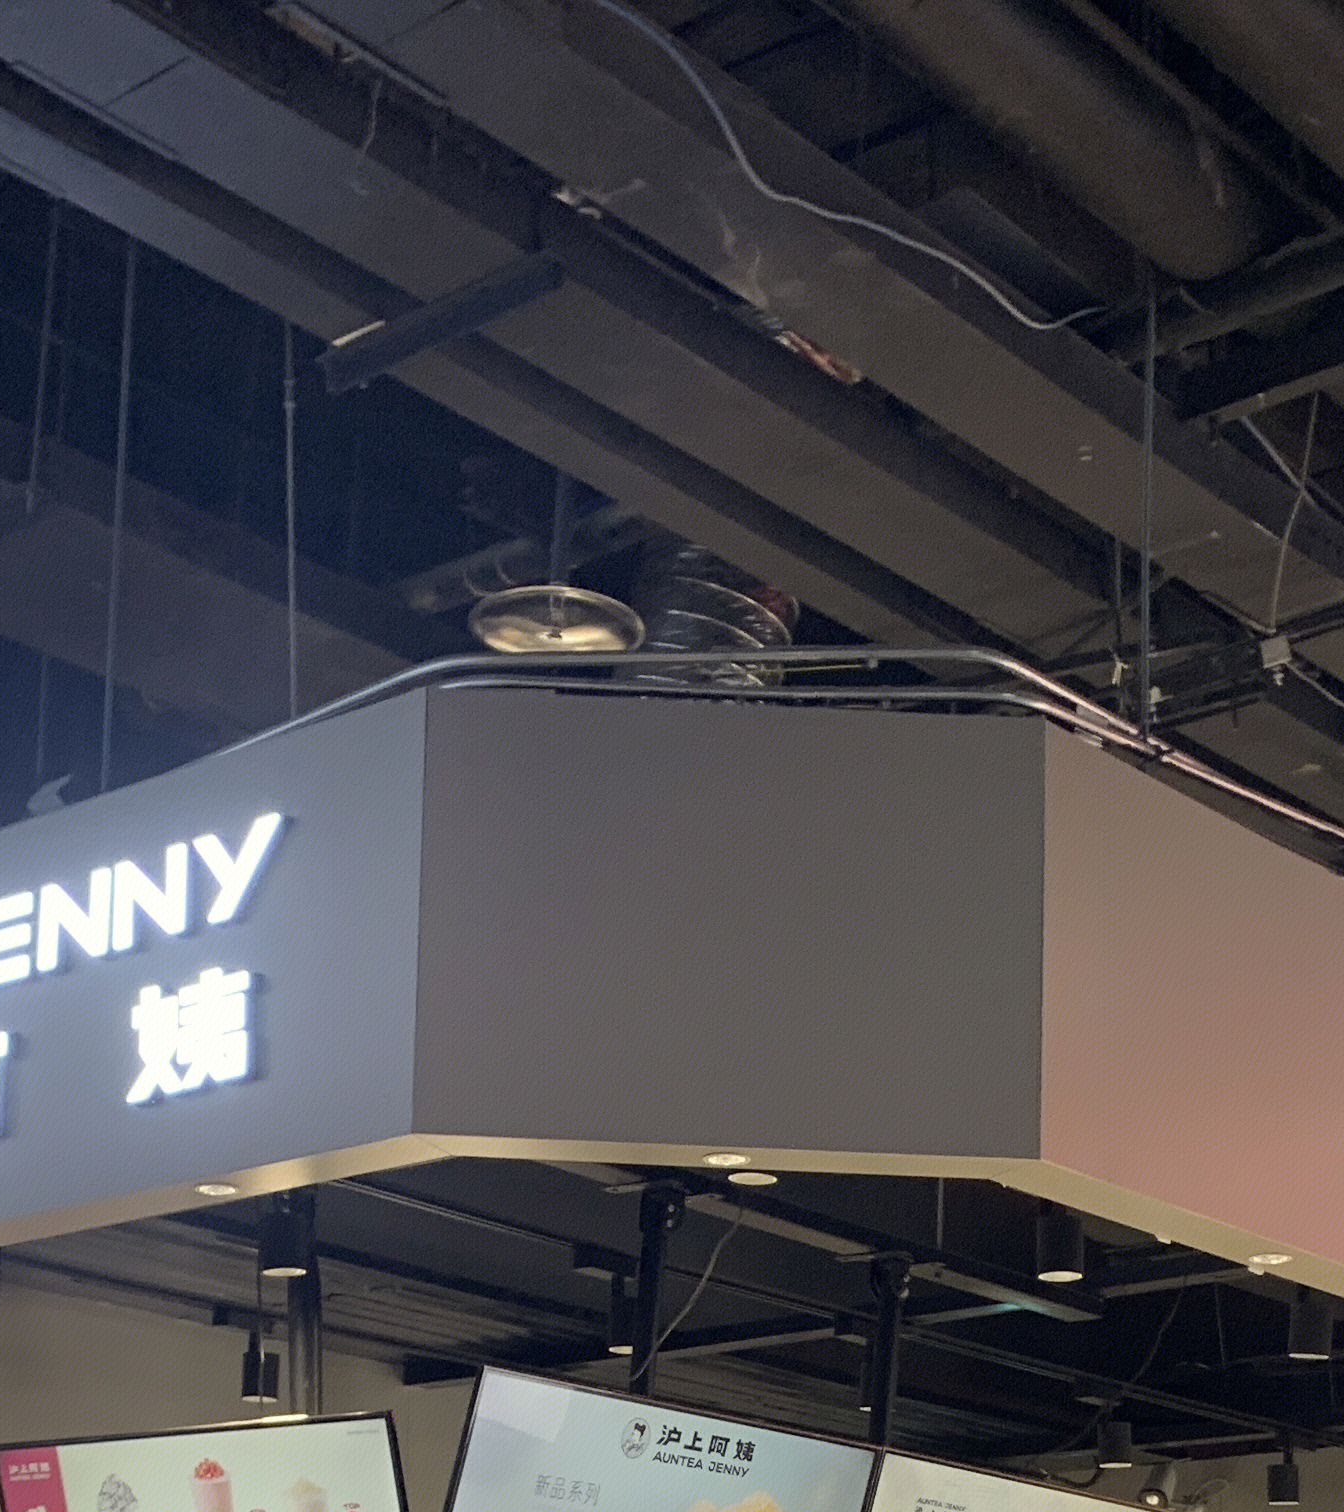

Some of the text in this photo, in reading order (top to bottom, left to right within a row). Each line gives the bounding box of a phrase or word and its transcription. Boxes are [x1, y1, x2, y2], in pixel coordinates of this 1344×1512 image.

[656, 1424, 756, 1462] 沪上阿姨
[652, 1450, 749, 1478] AUNTEA JENNY
[533, 1474, 601, 1506] 新品系列
